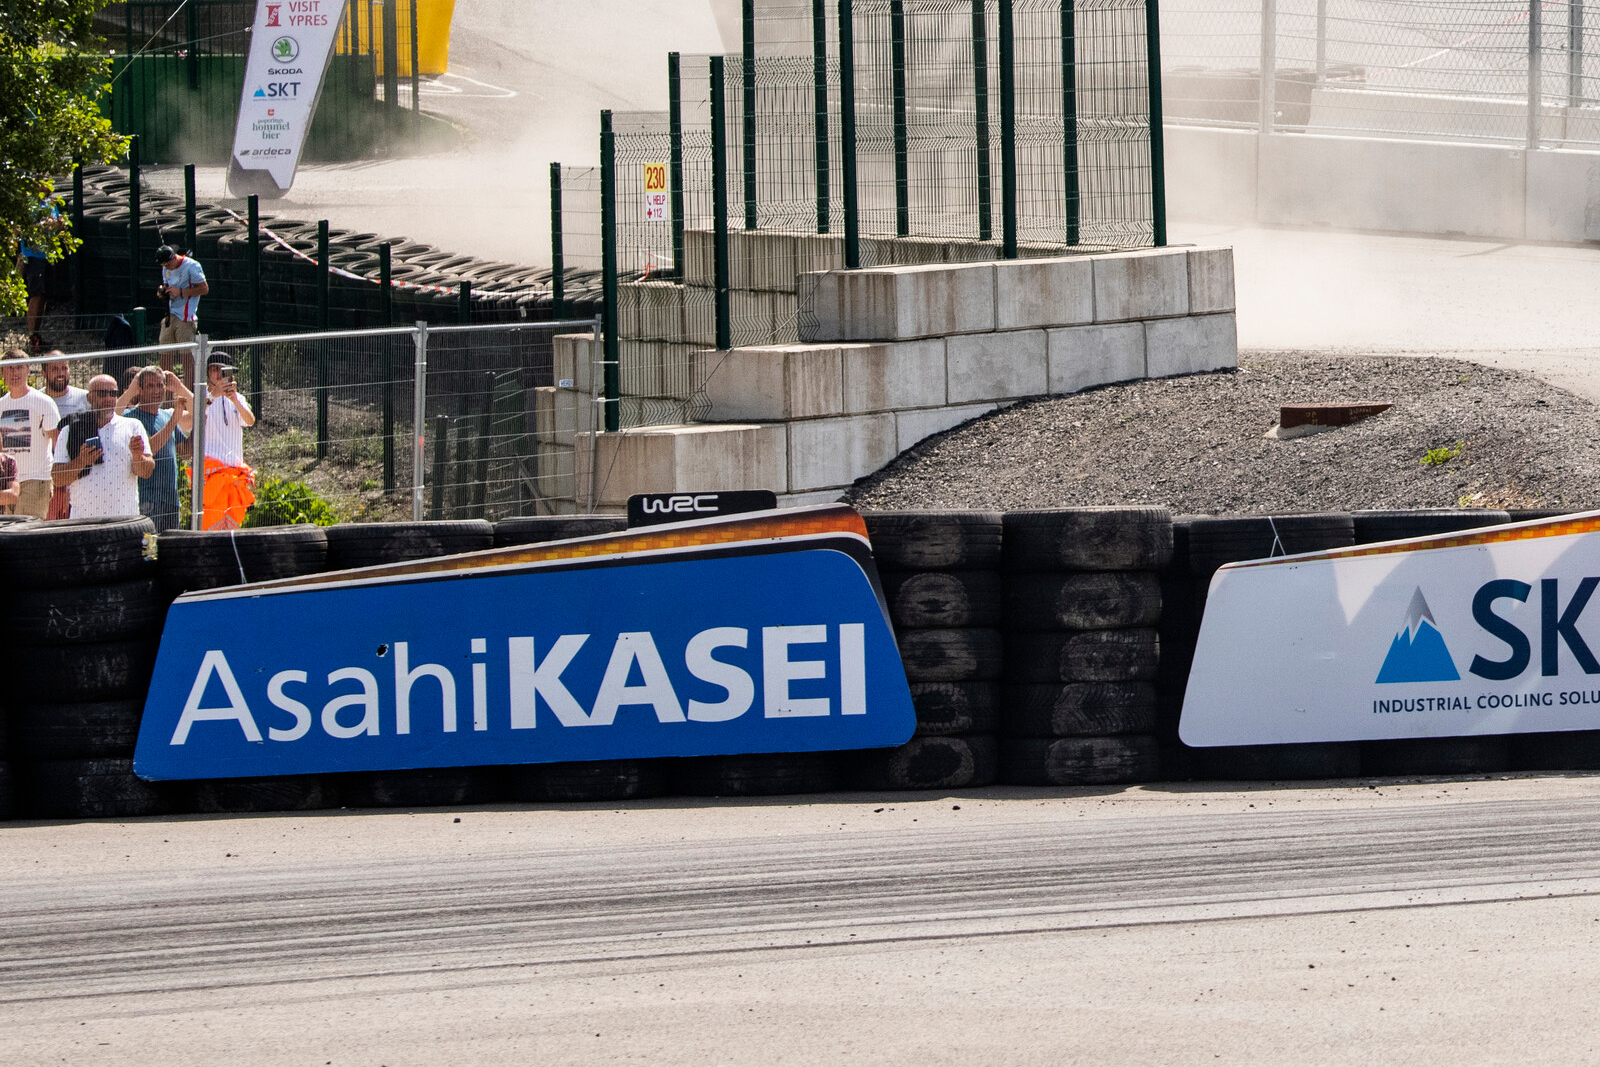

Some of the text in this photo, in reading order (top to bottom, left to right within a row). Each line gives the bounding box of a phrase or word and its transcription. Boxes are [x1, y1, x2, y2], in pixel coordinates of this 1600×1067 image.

[289, 0, 320, 13] VISIT
[289, 14, 328, 26] YPRES
[267, 82, 301, 97] SKT
[252, 122, 290, 131] hommel
[262, 131, 281, 140] bier
[252, 147, 292, 155] ardeca
[646, 166, 665, 190] 230
[653, 195, 666, 205] HELP
[653, 208, 663, 218] 112
[642, 494, 719, 514] WRC
[170, 622, 868, 746] AsahiKASEI
[1372, 696, 1472, 714] INDUSTRIAL
[1476, 692, 1553, 710] COOLING
